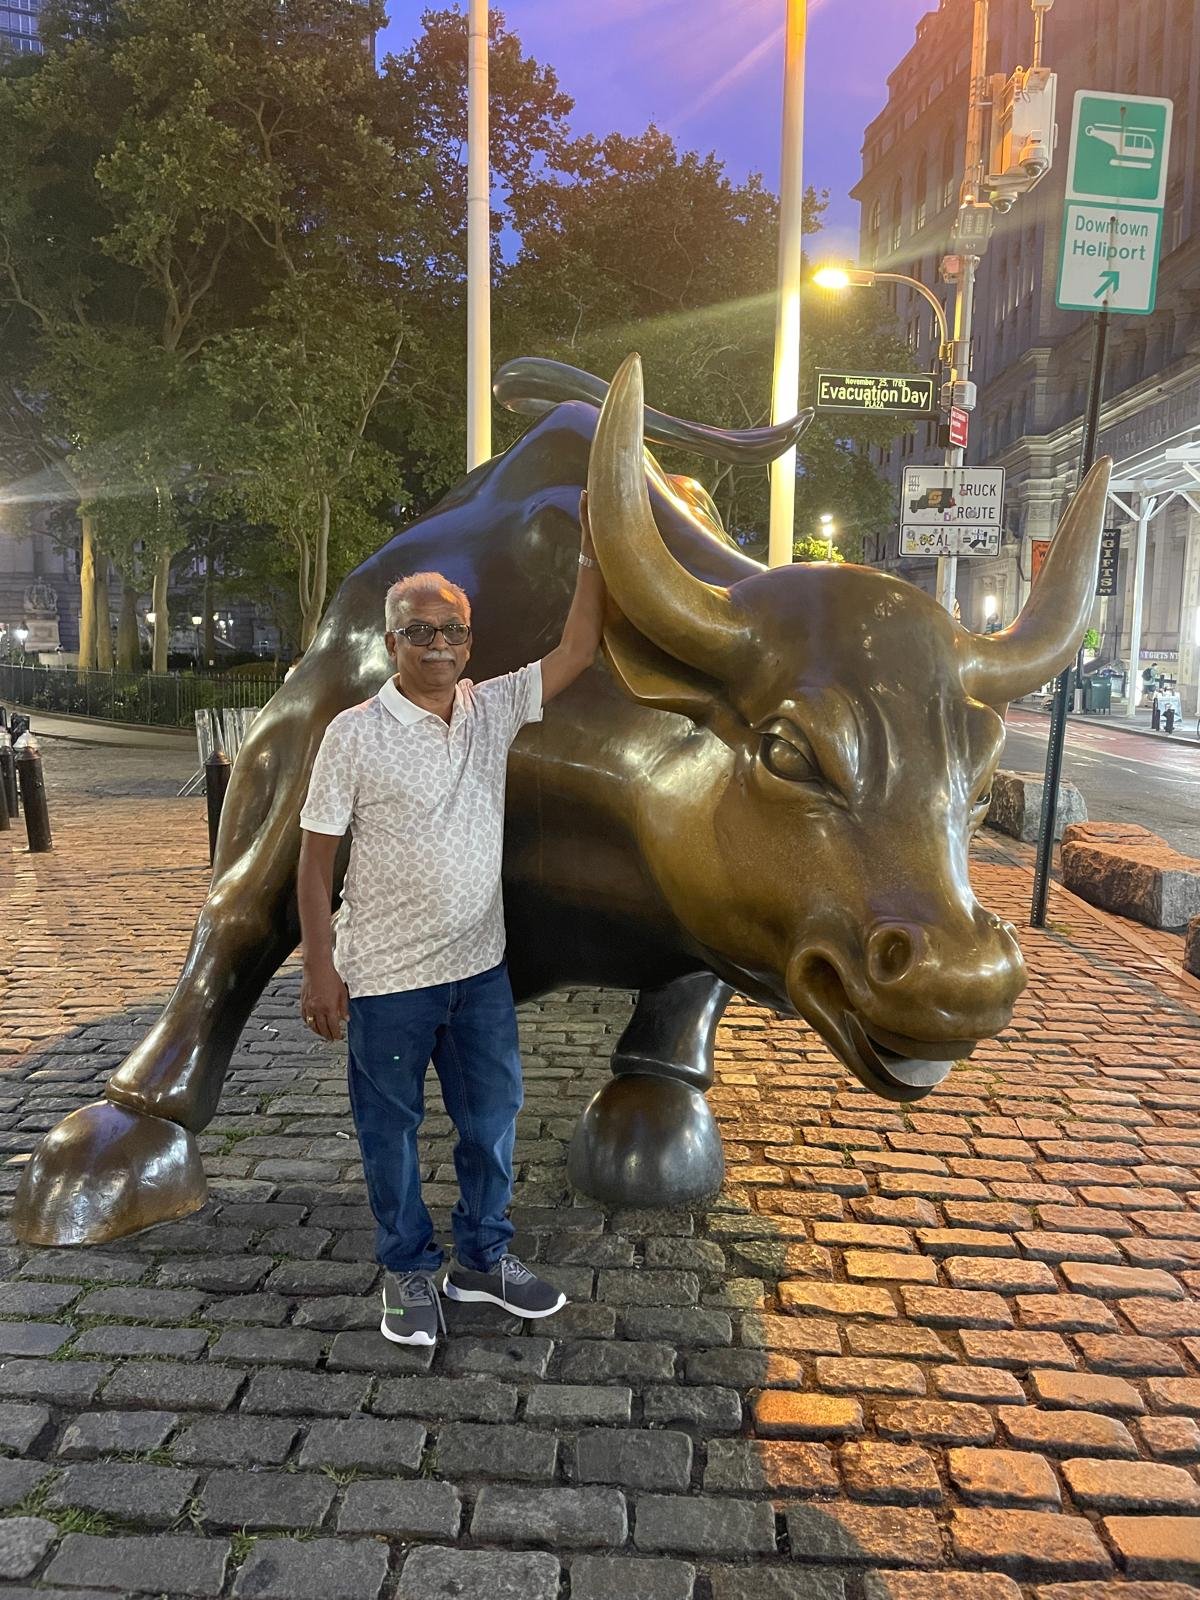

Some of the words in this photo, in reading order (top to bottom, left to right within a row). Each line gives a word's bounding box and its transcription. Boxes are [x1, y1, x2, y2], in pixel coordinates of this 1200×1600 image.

[1075, 215, 1149, 237] Downtown
[1072, 239, 1146, 261] Heliport
[845, 377, 875, 386] November
[821, 382, 899, 402] Evacuation
[901, 387, 928, 408] Day
[864, 401, 884, 409] PLAZA
[959, 483, 997, 497] TRUCK
[956, 506, 996, 519] ROUTE
[1100, 540, 1115, 587] GIFTS
